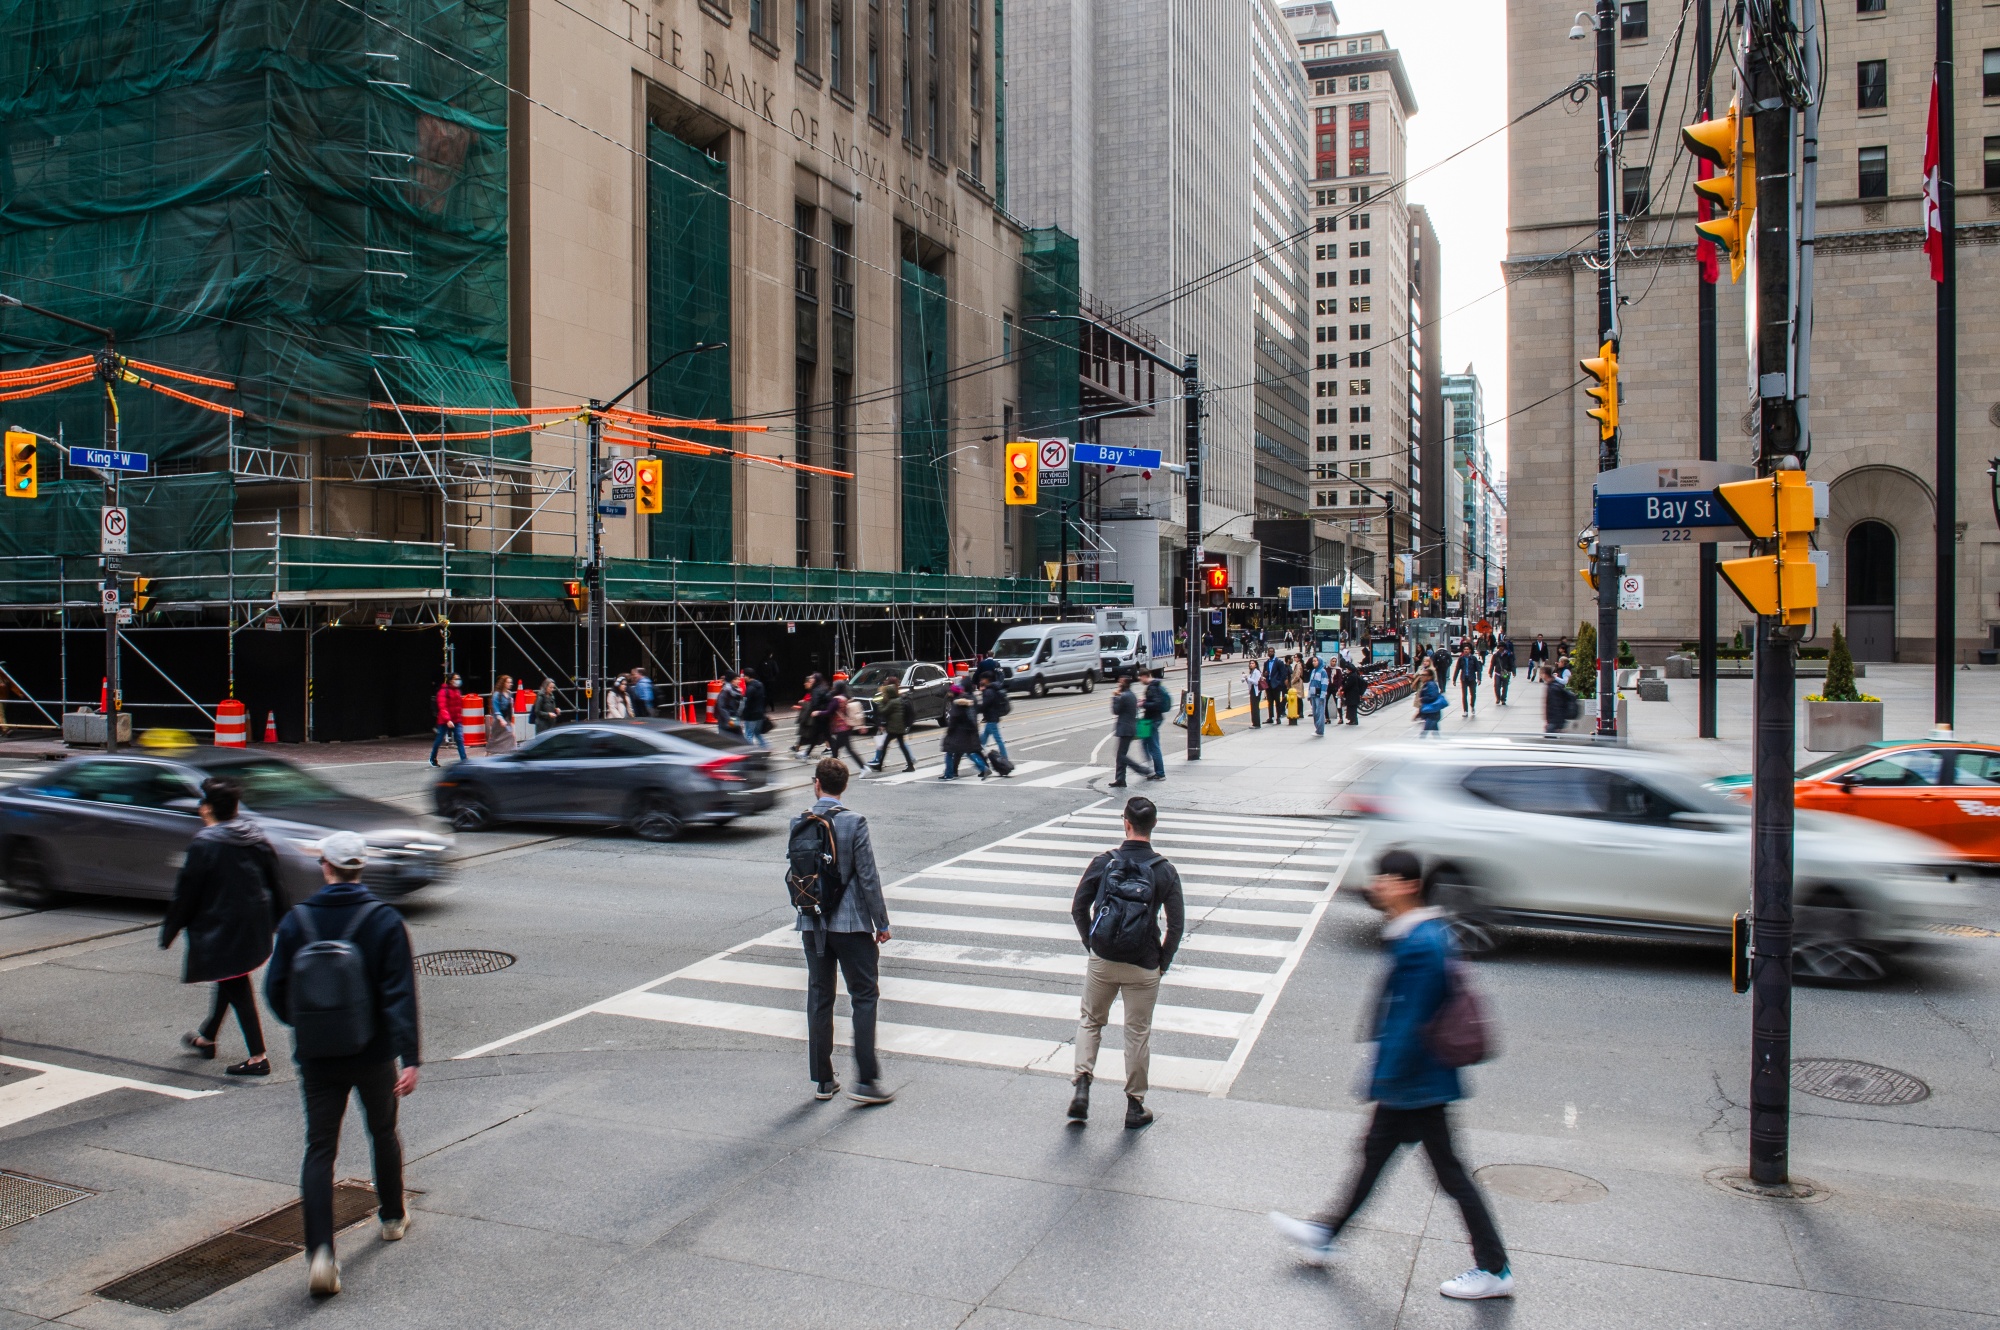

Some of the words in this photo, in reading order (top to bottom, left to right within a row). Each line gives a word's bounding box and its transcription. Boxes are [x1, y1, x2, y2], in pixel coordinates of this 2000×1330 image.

[623, 0, 684, 71] THE
[704, 50, 776, 126] BANK
[791, 108, 819, 150] OF
[833, 130, 889, 195] NOVA
[899, 175, 960, 238] SCOTIA
[87, 450, 111, 467] King
[121, 453, 131, 466] W
[1099, 447, 1123, 464] Bay
[1128, 449, 1136, 457] St
[1647, 497, 1688, 524] Bay
[1694, 500, 1711, 518] St
[1662, 529, 1691, 541] 222
[1059, 639, 1070, 648] ICS
[1070, 638, 1094, 648] Courier
[1151, 629, 1174, 657] DIANA'S
